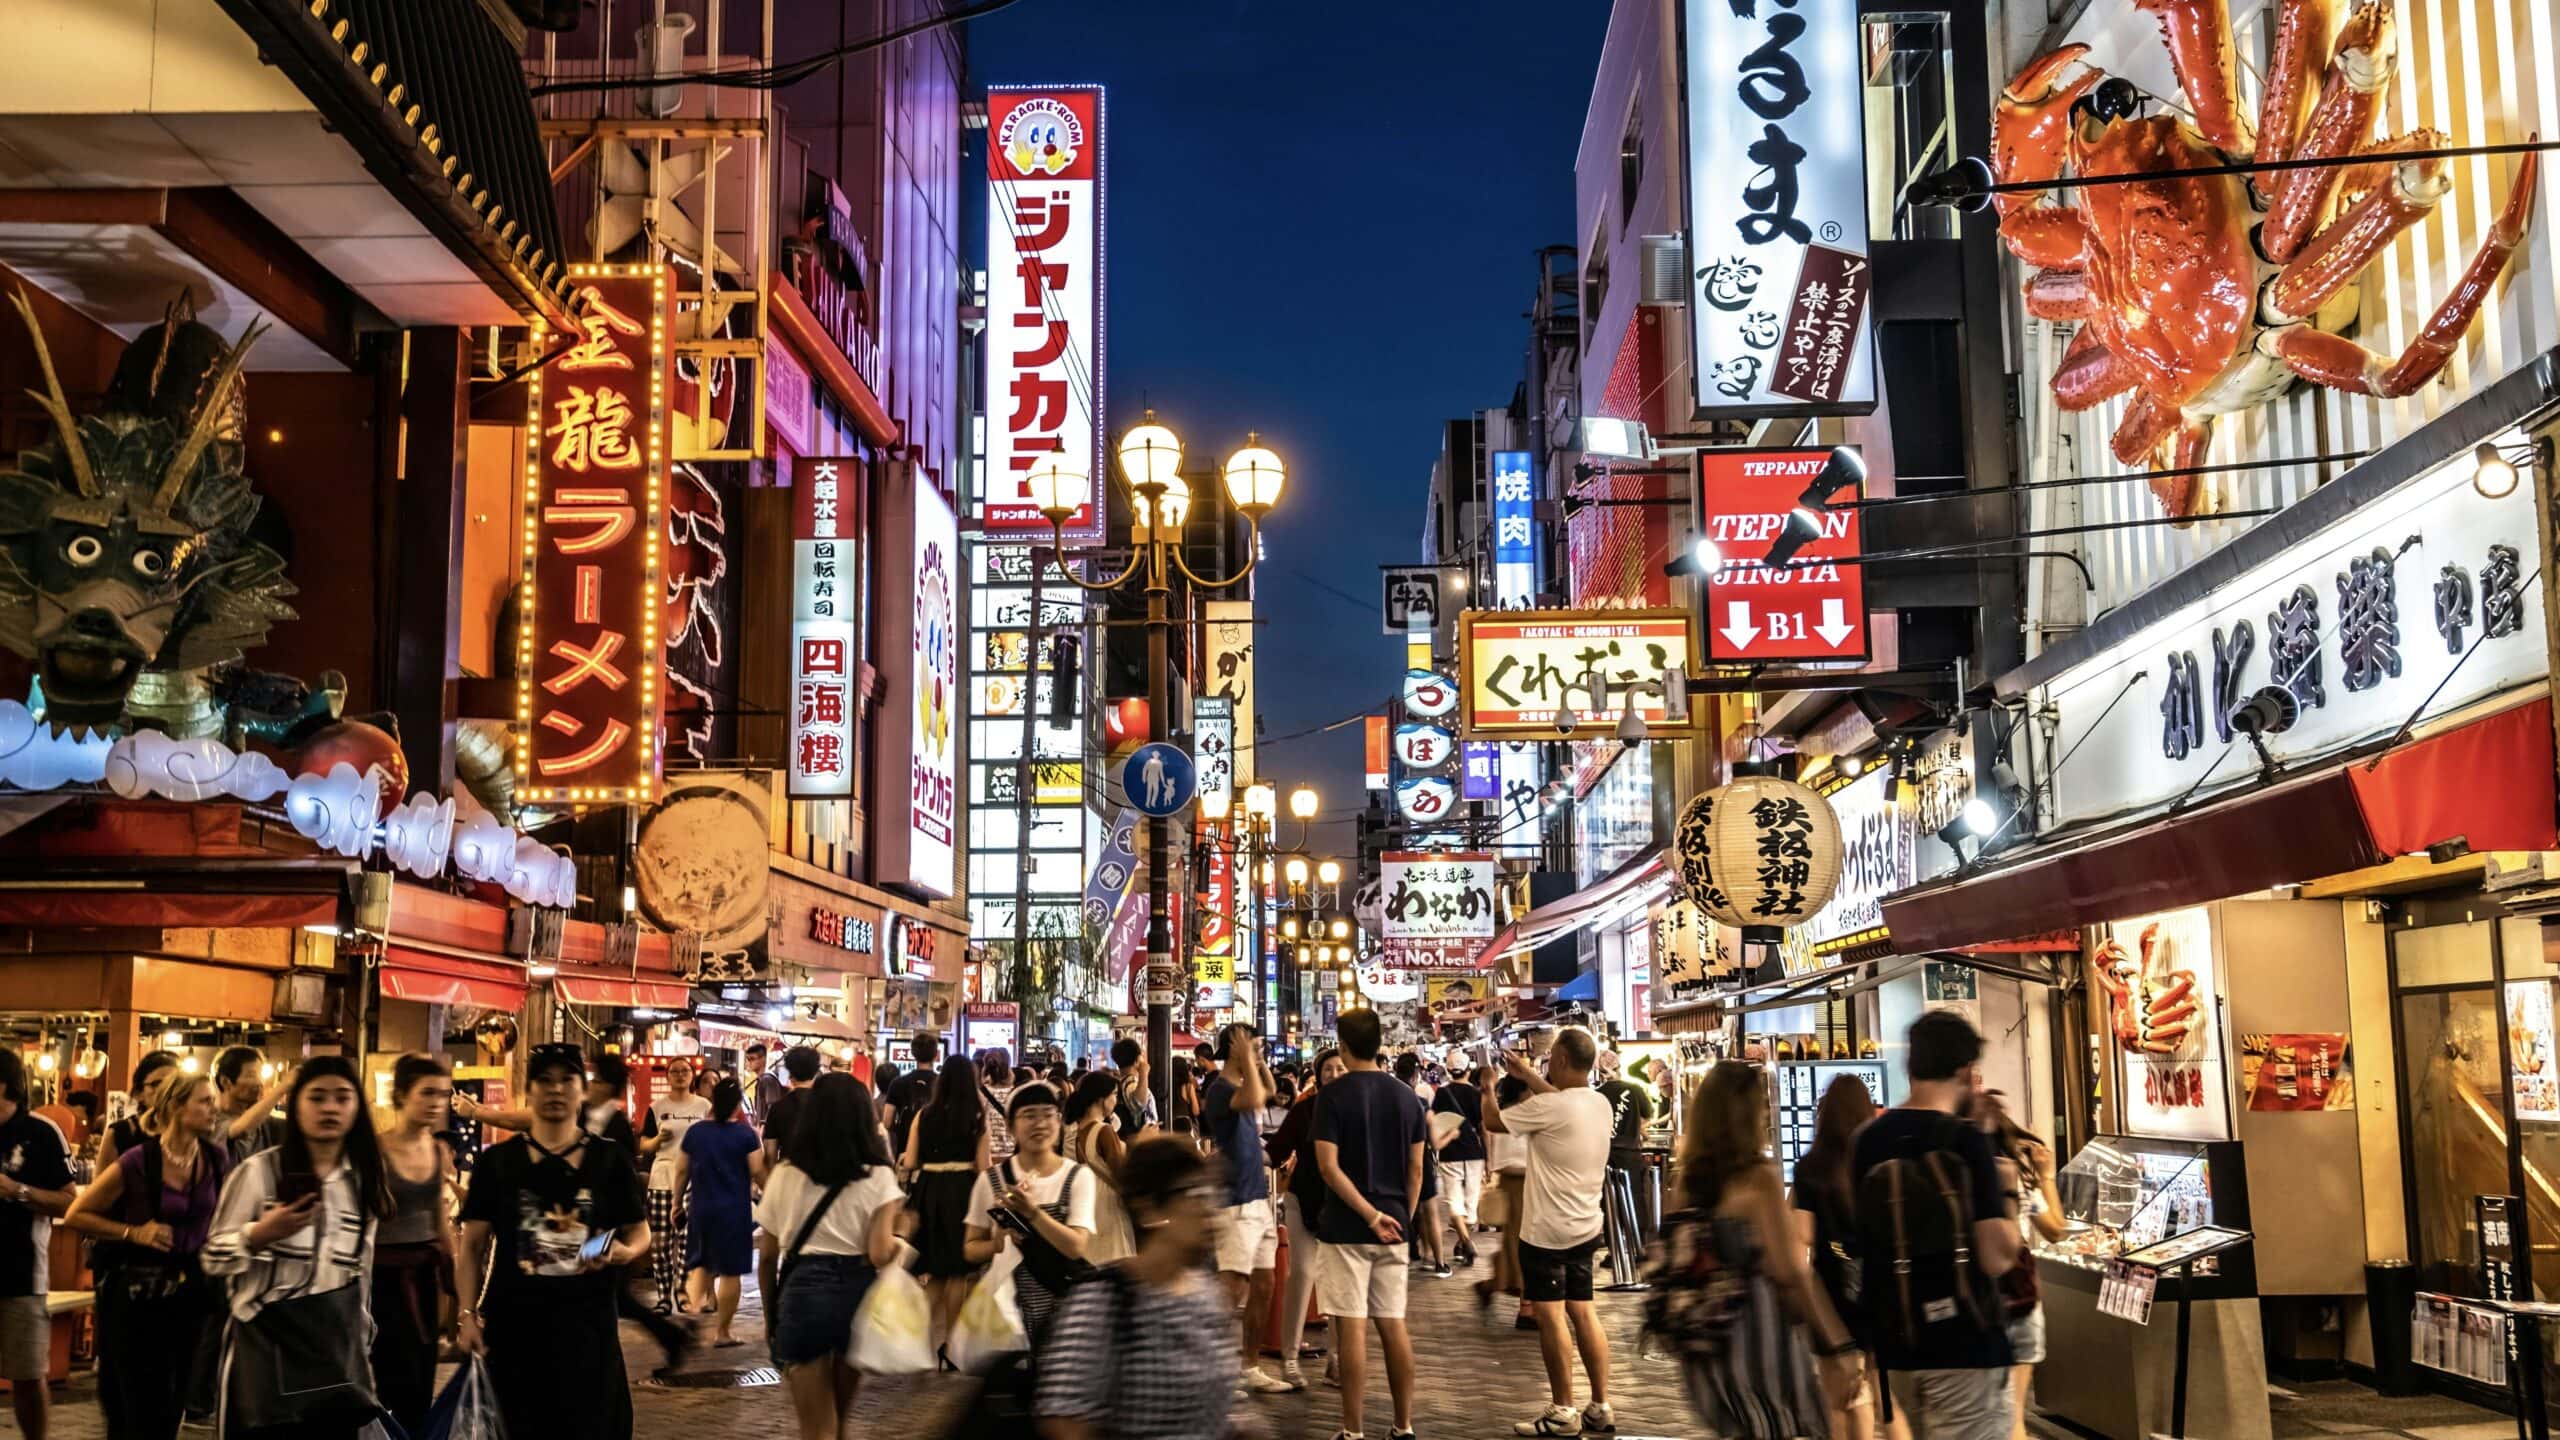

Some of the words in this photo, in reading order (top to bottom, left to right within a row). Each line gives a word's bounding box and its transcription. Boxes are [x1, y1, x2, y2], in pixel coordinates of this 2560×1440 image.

[1727, 0, 1813, 245] るま
[539, 286, 645, 777] 金龍ラーメン
[1495, 470, 1532, 547] 焼肉
[812, 542, 836, 617] 回転寿司
[1766, 612, 1808, 641] B1
[1748, 796, 1814, 917] 鉄板神社
[1385, 880, 1492, 923] わなか
[970, 1004, 1014, 1014] KARAOKE
